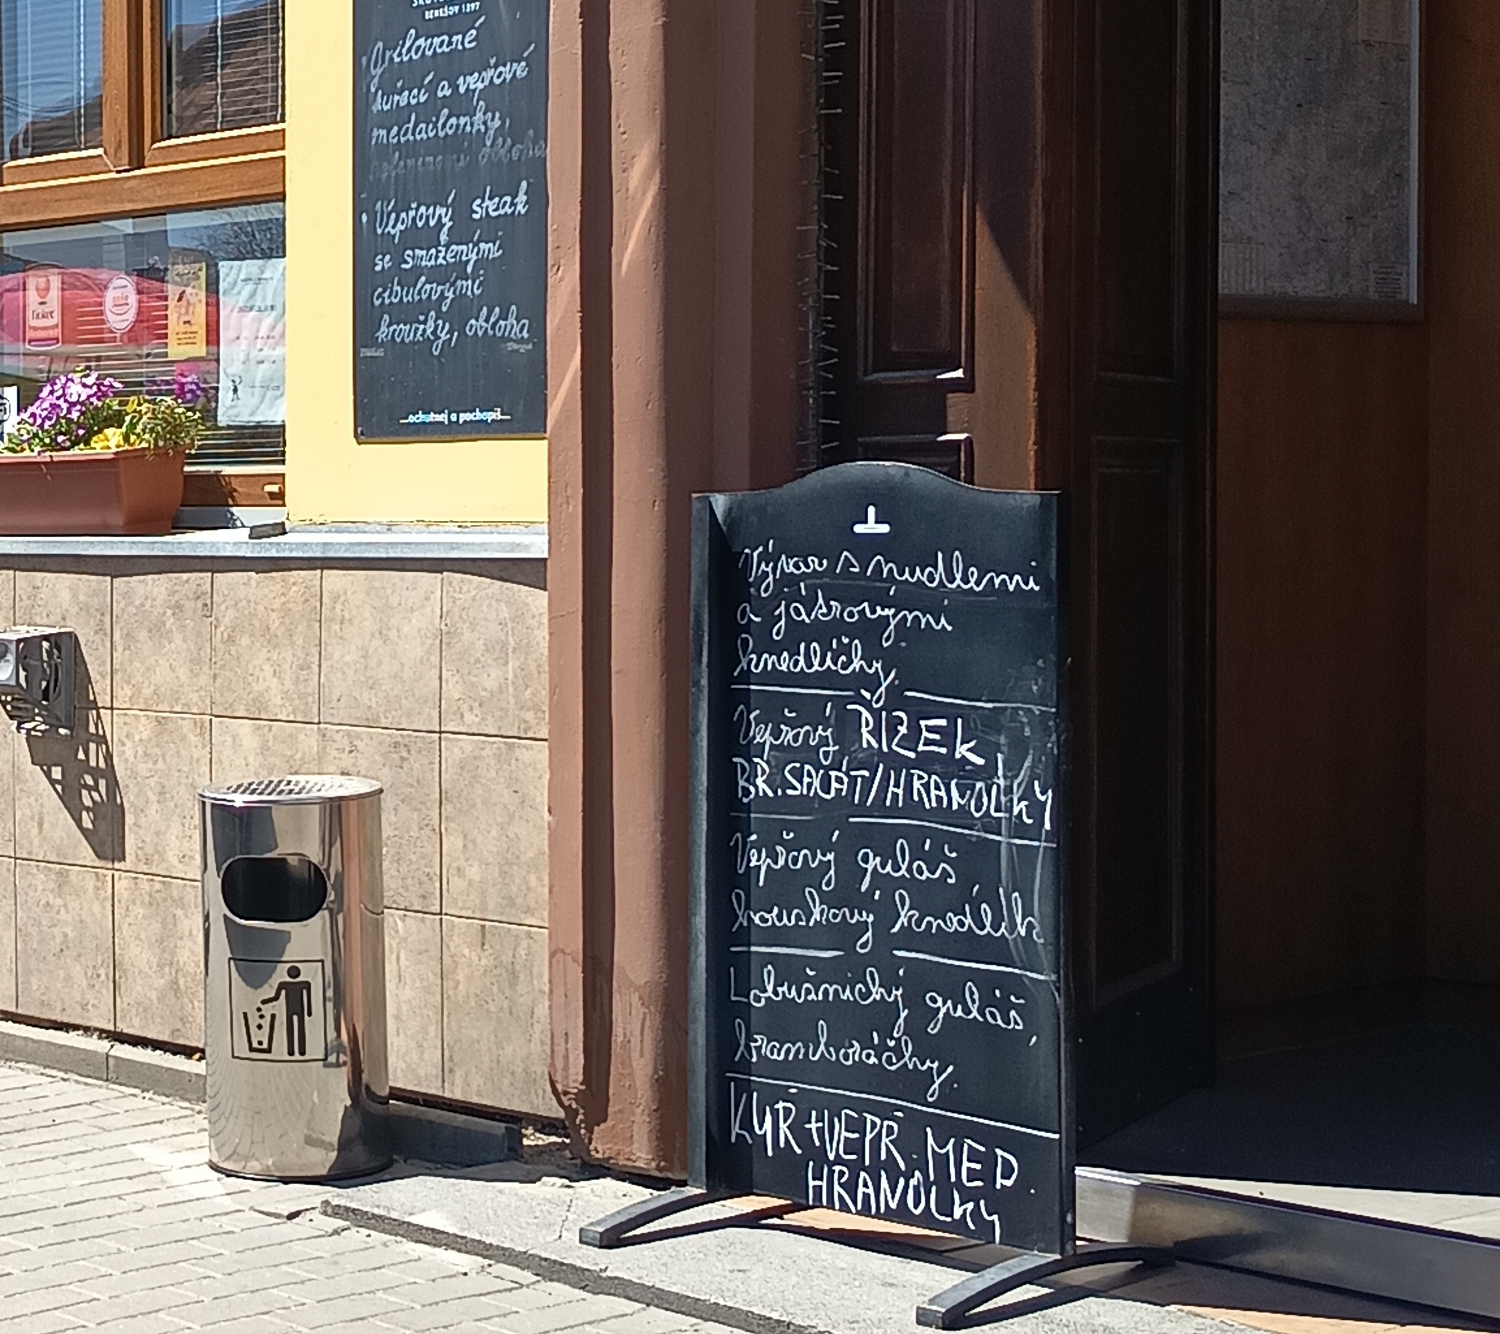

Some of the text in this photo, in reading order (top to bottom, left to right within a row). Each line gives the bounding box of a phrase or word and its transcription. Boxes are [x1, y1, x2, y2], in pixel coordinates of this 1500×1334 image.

[370, 15, 486, 93] Grilované
[372, 43, 536, 114] kuřecí a vepřové
[375, 179, 529, 244] Vepřový steak
[374, 229, 503, 273] se smaženými
[373, 270, 485, 312] cibulovými
[466, 305, 529, 339] obloha
[738, 539, 1042, 598] Vývar s nudlemi
[737, 602, 762, 623] a
[733, 702, 840, 765] Vepřový
[729, 829, 841, 892] Vepřový
[731, 888, 882, 954] houskový
[806, 1160, 1001, 1245] HRANOLKY
